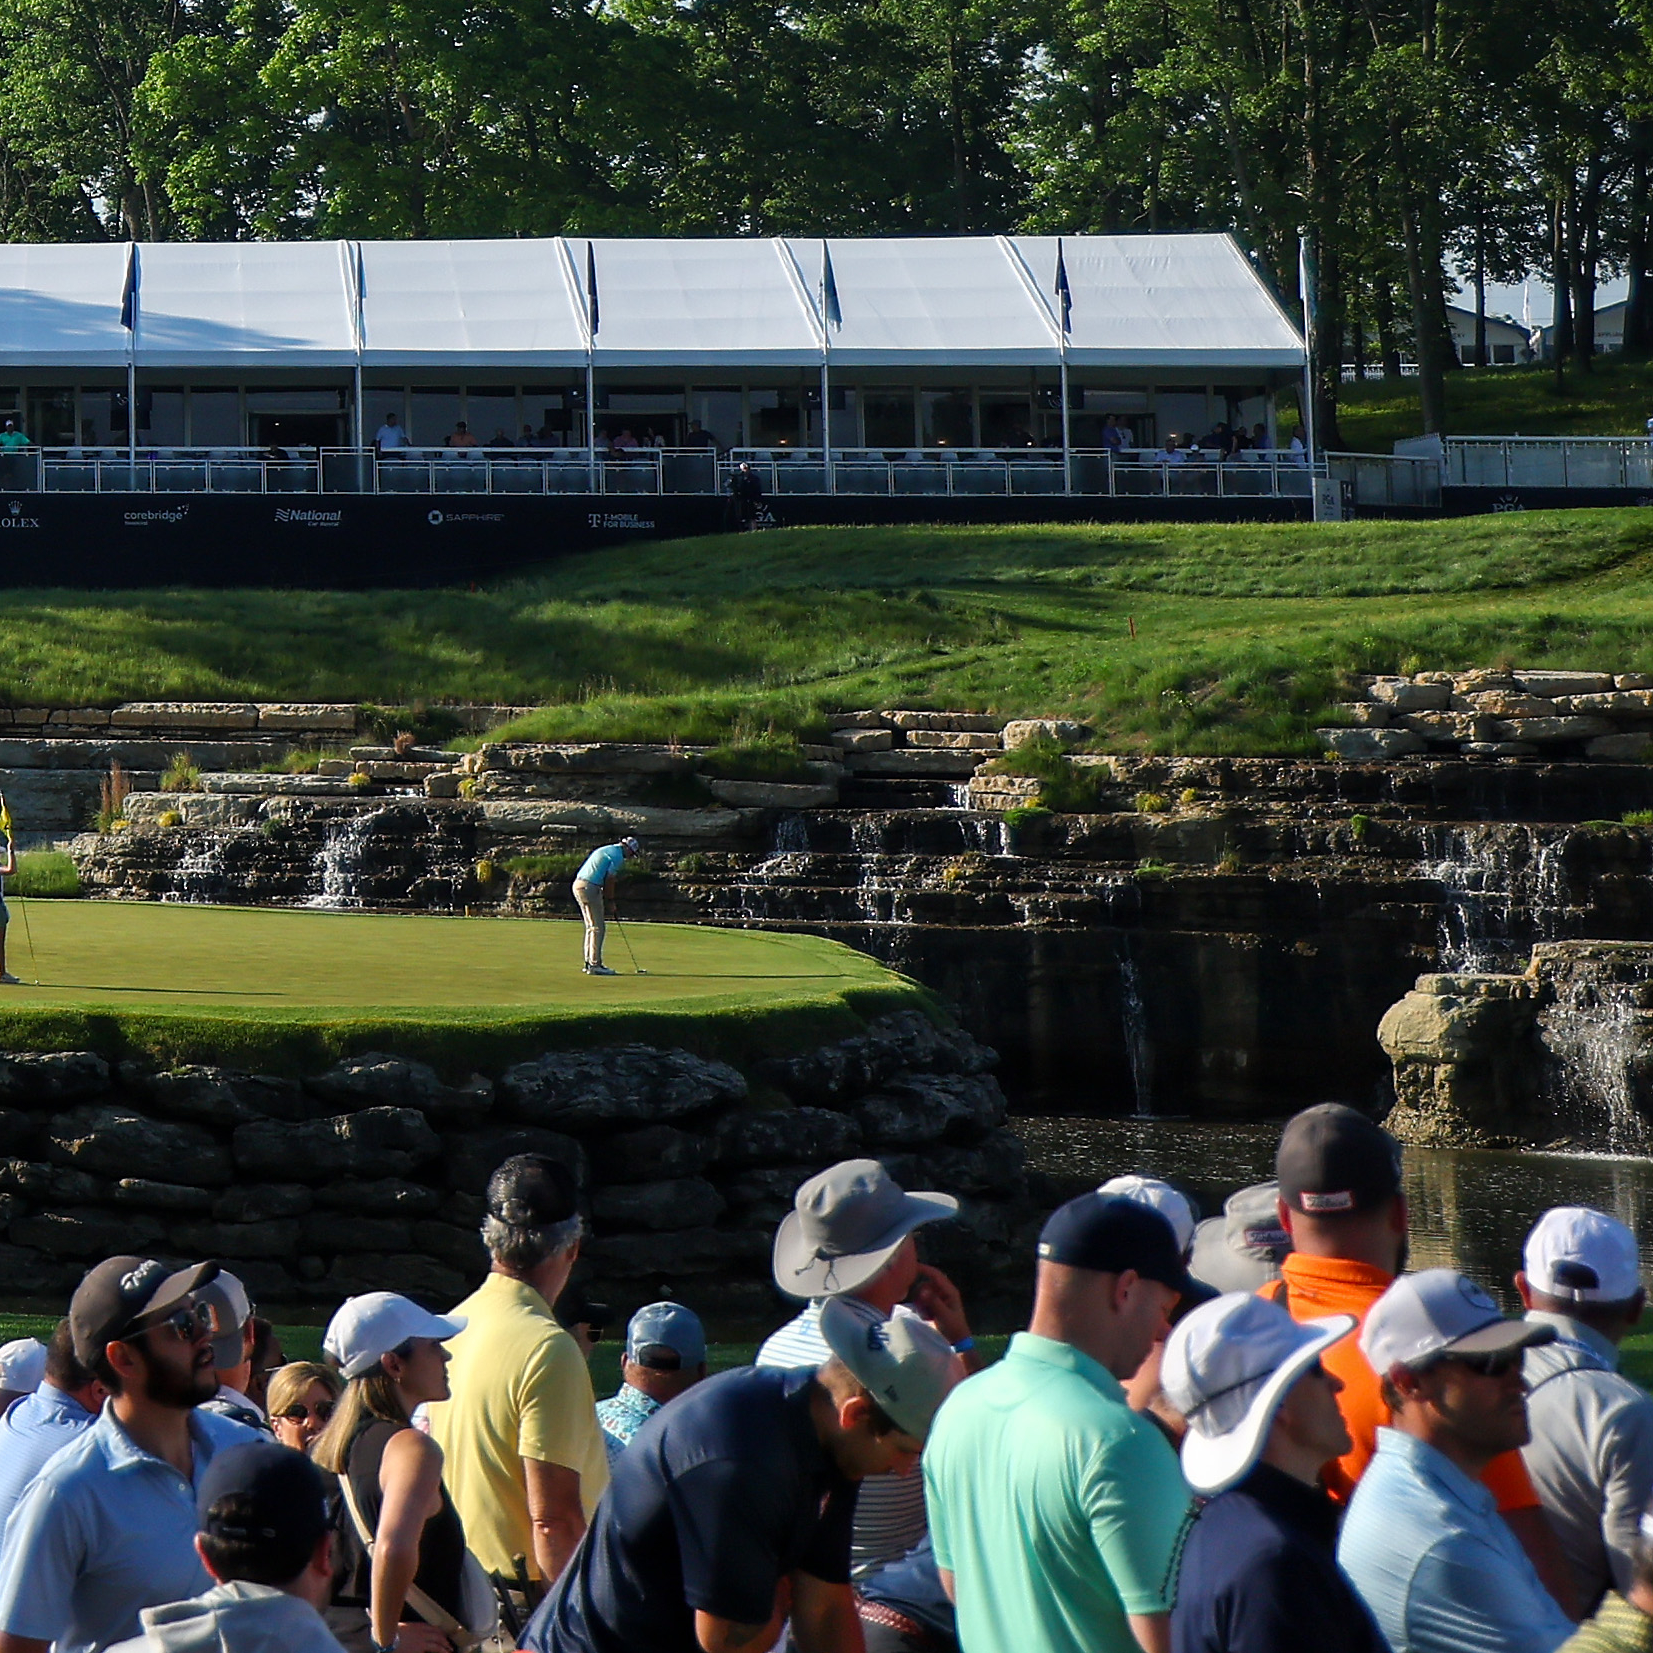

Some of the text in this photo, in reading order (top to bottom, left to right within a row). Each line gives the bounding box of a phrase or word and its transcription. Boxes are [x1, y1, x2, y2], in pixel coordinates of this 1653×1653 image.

[124, 510, 183, 523] corebridge
[290, 510, 342, 521] National
[445, 513, 502, 522] SAPPHIRE
[603, 513, 639, 521] T-MOBILE
[755, 511, 777, 523] GA
[603, 520, 655, 529] FOR BUSINESS
